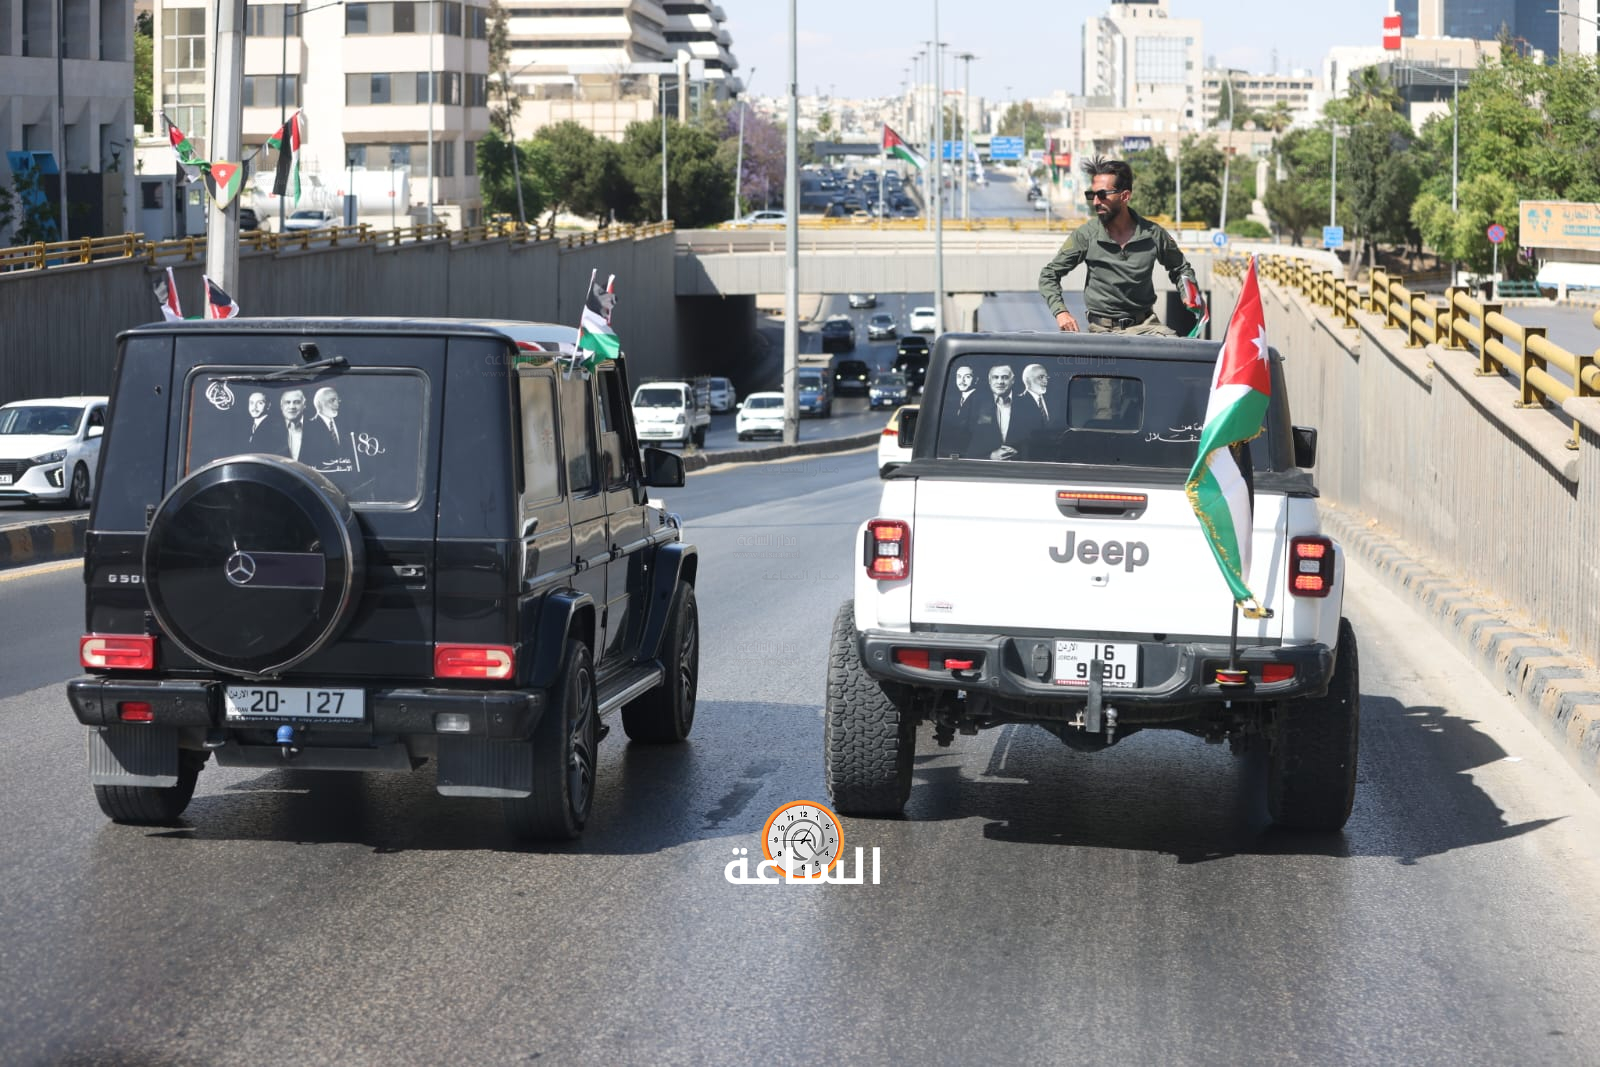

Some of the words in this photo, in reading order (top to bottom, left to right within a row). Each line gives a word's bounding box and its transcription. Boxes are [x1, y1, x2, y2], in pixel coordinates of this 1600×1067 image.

[1048, 530, 1150, 573] Jeep
[1094, 644, 1115, 660] 16
[1076, 662, 1126, 679] 990
[306, 691, 345, 714] 127
